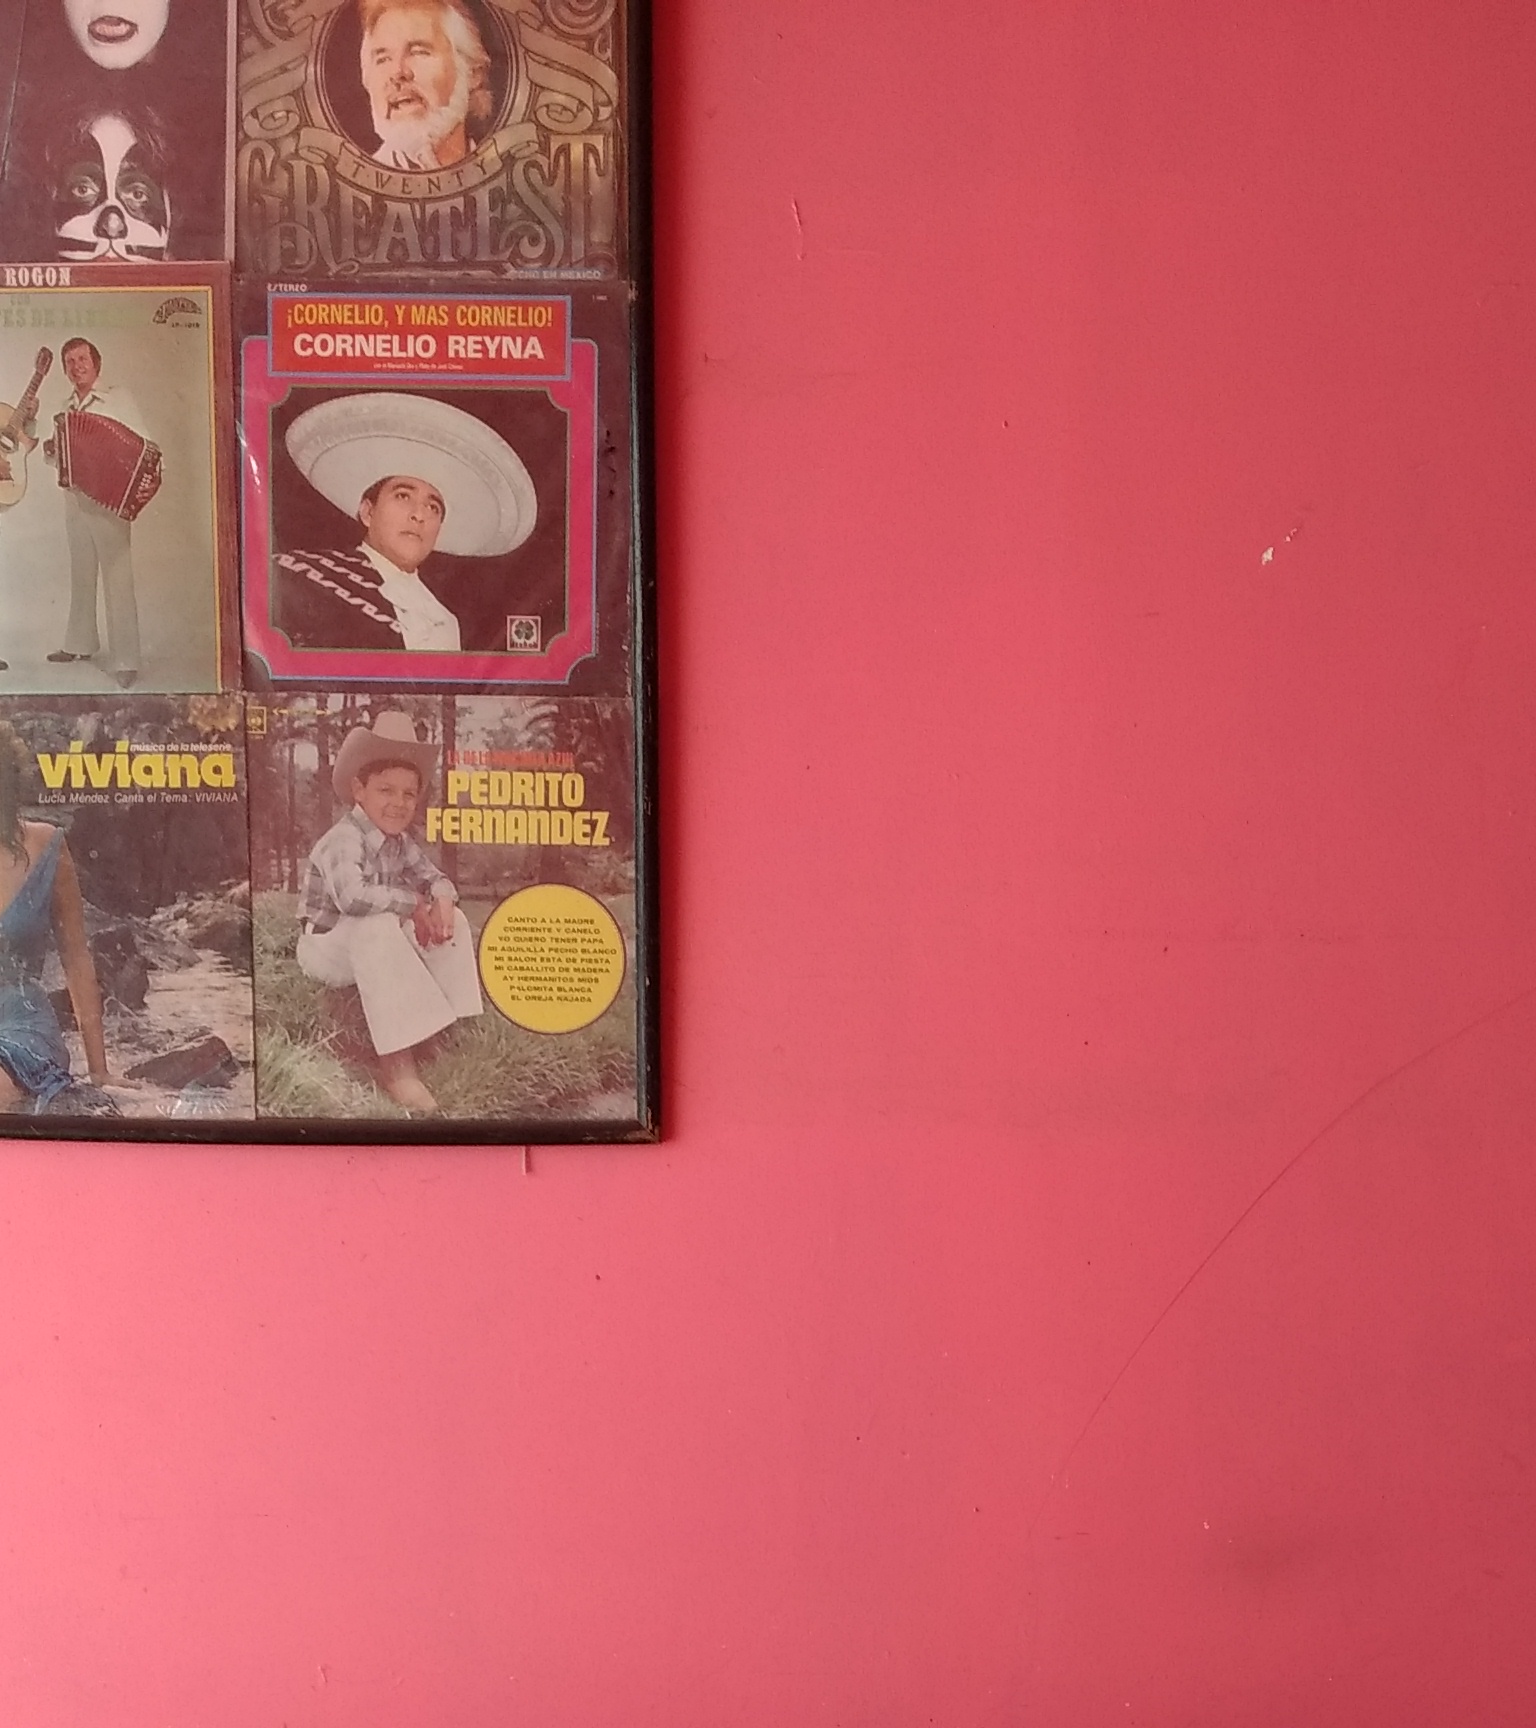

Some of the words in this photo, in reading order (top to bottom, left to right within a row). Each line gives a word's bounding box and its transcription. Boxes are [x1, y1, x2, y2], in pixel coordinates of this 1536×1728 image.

[351, 157, 490, 195] TWENTY
[237, 133, 609, 274] GREATEST
[394, 304, 406, 326] Y
[411, 305, 449, 327] MAS
[455, 305, 554, 329] CORNELIO!
[293, 332, 437, 361] CORNELIO
[447, 334, 546, 361] REYNA
[166, 742, 180, 752] de
[180, 742, 190, 752] la
[36, 740, 237, 789] viviana
[114, 792, 144, 804] Canta
[146, 792, 157, 804] el
[194, 793, 239, 804] VIVIANA
[447, 769, 585, 809] PEDRITO
[425, 807, 612, 848] FERNANDEZ
[507, 916, 537, 924] CANTO
[564, 927, 601, 935] CANELO
